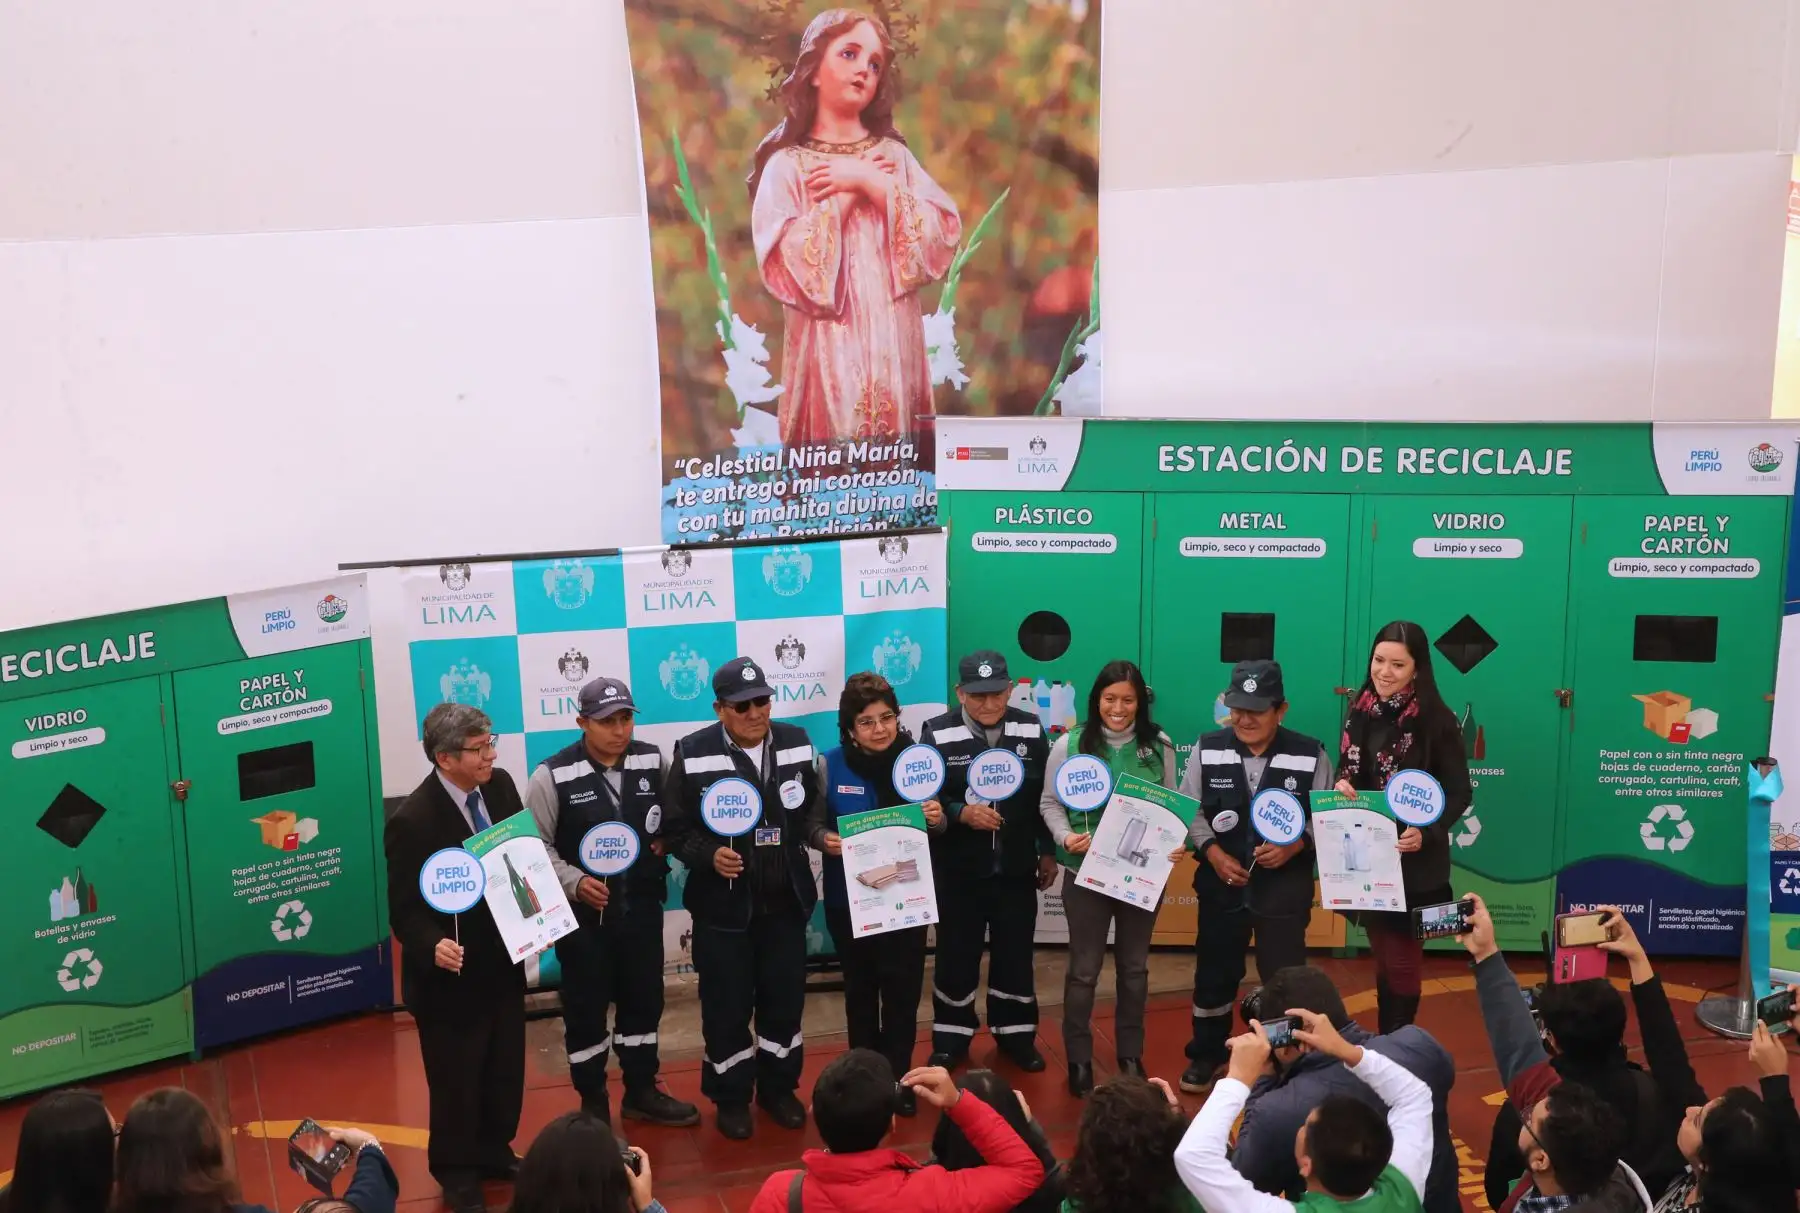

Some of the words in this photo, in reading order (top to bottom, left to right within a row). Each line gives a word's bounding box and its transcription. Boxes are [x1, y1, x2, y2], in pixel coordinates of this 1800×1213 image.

[674, 448, 783, 480] “Celestial
[788, 446, 841, 470] Niña
[847, 439, 919, 464] María,
[1158, 438, 1327, 475] ESTACIÓN
[1340, 446, 1384, 474] DE
[1397, 447, 1573, 476] RECICLAJE
[1690, 447, 1719, 460] PERÚ
[1017, 463, 1058, 473] LIMA
[1685, 462, 1723, 472] LIMPIO
[675, 486, 696, 508] te
[701, 480, 787, 506] entrego
[792, 471, 820, 494] mi
[825, 465, 922, 491] corazón,
[677, 513, 718, 534] con
[722, 505, 746, 528] tu
[751, 495, 830, 524] manita
[836, 488, 906, 515] divina
[994, 502, 1093, 526] PLÁSTICO
[1219, 511, 1287, 531] METAL
[1432, 511, 1506, 531] VIDRIO
[1643, 514, 1706, 533] PAPEL
[1714, 515, 1730, 533] Y
[976, 536, 1014, 549] Limpio,
[1015, 540, 1038, 548] seco
[1040, 540, 1047, 551] y
[1049, 537, 1112, 551] compactado
[1184, 541, 1222, 554] Limpio,
[1249, 545, 1256, 556] y
[1258, 541, 1321, 555] compactado
[1434, 542, 1467, 555] Limpio
[1469, 545, 1476, 556] y
[1640, 533, 1730, 555] CARTÓN
[860, 565, 917, 575] MUNICIPALIDAD
[918, 564, 929, 572] DE
[1613, 561, 1650, 575] Limpio,
[1653, 565, 1677, 573] seco
[1680, 565, 1687, 577] y
[1689, 562, 1755, 576] compactado
[643, 579, 703, 589] MUNICIPALIDAD
[705, 578, 713, 586] DE
[859, 576, 930, 598] LIMA
[421, 593, 483, 602] MUNICIPALIDAD
[643, 590, 716, 611] LIMA
[265, 607, 291, 621] PERÚ
[422, 604, 497, 624] LIMA
[262, 620, 296, 633] LIMPIO
[0, 631, 156, 682] ECICLAJE
[240, 673, 290, 694] PAPEL
[292, 669, 305, 684] Y
[767, 672, 815, 680] UNICIPALIDAD
[239, 686, 308, 712] CARTÓN
[774, 682, 827, 702] IMA
[24, 708, 88, 733] VIDRIO
[221, 715, 251, 731] Limpio,
[253, 712, 271, 725] seco
[272, 711, 279, 724] y
[279, 703, 329, 721] compactado
[29, 738, 59, 753] Limpio
[61, 737, 66, 749] y
[67, 734, 88, 746] seco
[905, 756, 933, 773] PERÚ
[1600, 749, 1630, 760] Papel
[1633, 752, 1652, 760] con
[1665, 751, 1681, 760] sin
[1684, 750, 1708, 760] tinta
[1711, 753, 1743, 763] negra
[982, 760, 1011, 774] PERÚ
[1068, 766, 1097, 784] PERÚ
[1469, 767, 1505, 776] nvases
[1600, 762, 1629, 773] hojas
[1632, 762, 1646, 772] de
[1649, 762, 1703, 774] cuaderno,
[1707, 763, 1741, 773] cartón
[902, 771, 938, 788] LIMPIO
[977, 774, 1016, 787] LIMPIO
[1598, 775, 1656, 787] corrugado,
[1660, 776, 1710, 786] cartulina,
[1713, 777, 1741, 787] craft,
[1065, 781, 1105, 797] LIMPIO
[1401, 783, 1433, 801] PERÚ
[1615, 788, 1643, 797] entre
[1646, 788, 1672, 797] otros
[1675, 788, 1723, 798] similares
[717, 792, 748, 806] PERÚ
[1394, 794, 1434, 815] LIMPIO
[711, 807, 753, 819] LIMPIO
[1267, 800, 1296, 823] PERÚ
[1258, 806, 1293, 836] LIMPIO
[595, 834, 627, 848] PERÚ
[231, 867, 256, 878] Papel
[257, 861, 273, 872] con
[275, 860, 281, 868] o
[282, 856, 295, 866] sin
[296, 852, 315, 863] tinta
[317, 847, 341, 859] negra
[589, 849, 630, 861] LIMPIO
[233, 873, 257, 887] hojas
[258, 871, 270, 881] de
[271, 864, 313, 879] cuaderno,
[315, 856, 341, 868] cartón
[436, 862, 470, 881] PERÚ
[233, 882, 279, 898] corrugado,
[281, 871, 319, 887] cartulina,
[321, 867, 343, 878] craft,
[431, 880, 477, 896] LIMPIO
[247, 894, 270, 905] entre
[271, 888, 293, 900] otros
[294, 879, 331, 893] similares
[34, 925, 70, 939] Botellas
[72, 922, 78, 932] y
[80, 914, 117, 928] envases
[57, 934, 69, 944] de
[71, 928, 96, 941] vidrio
[226, 991, 241, 1003] NO
[241, 981, 286, 998] DEPOSITAR
[12, 1044, 27, 1056] NO
[28, 1032, 77, 1051] DEPOSITAR
